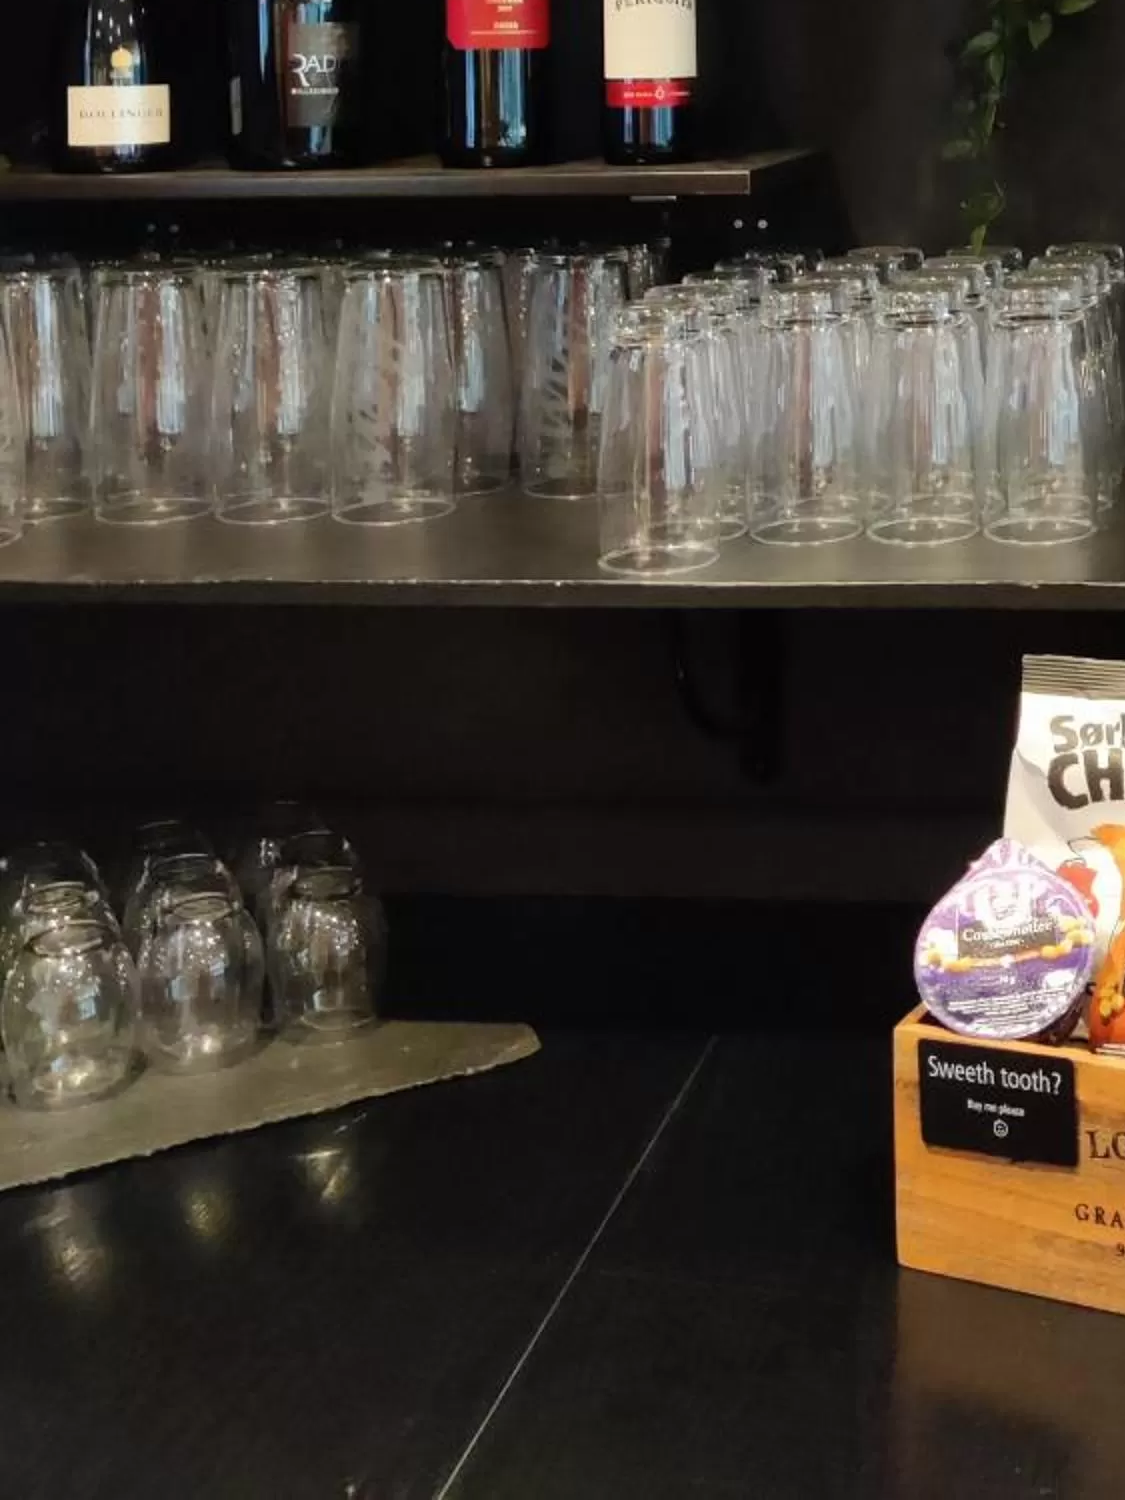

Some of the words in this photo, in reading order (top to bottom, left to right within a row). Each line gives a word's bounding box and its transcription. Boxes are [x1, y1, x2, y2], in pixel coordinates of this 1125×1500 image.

[927, 1055, 995, 1085] Sweeth
[1000, 1067, 1062, 1095] tooth?
[967, 1098, 983, 1113] Buy
[999, 1103, 1025, 1117] please
